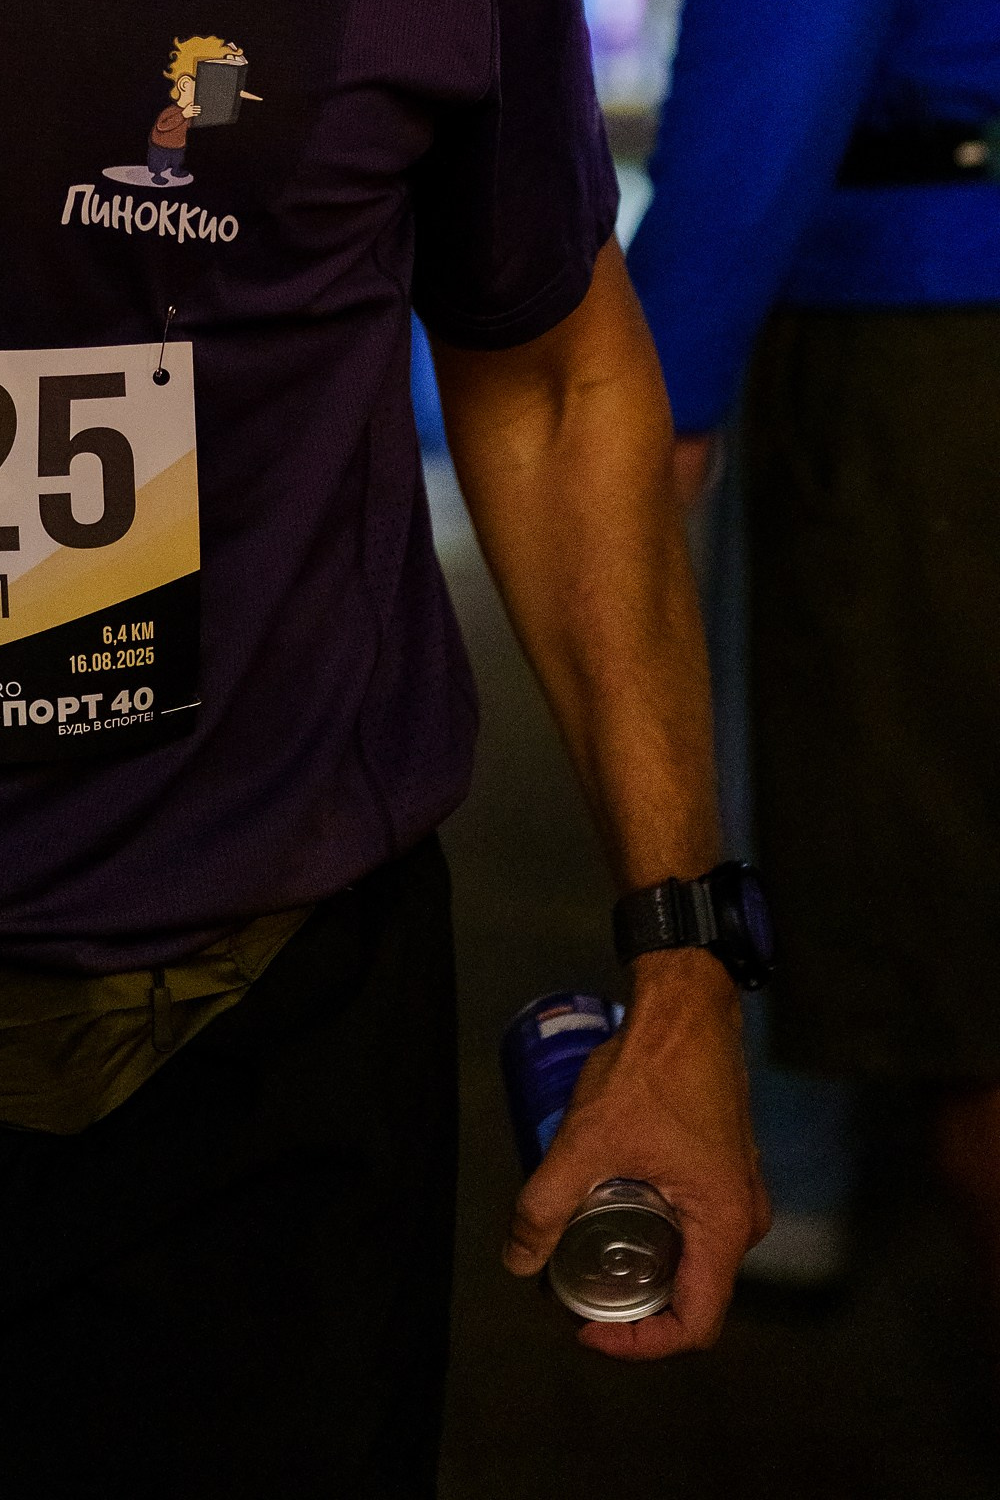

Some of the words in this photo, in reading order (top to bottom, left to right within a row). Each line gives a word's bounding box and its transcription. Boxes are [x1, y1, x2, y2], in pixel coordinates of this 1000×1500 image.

[102, 625, 128, 646] 6,4
[131, 621, 154, 642] КМ
[69, 646, 155, 674] 16.08.2025
[110, 686, 155, 714] 40
[58, 723, 91, 736] БУДЬ
[93, 720, 102, 732] В
[104, 711, 155, 730] СПОРТЕ!
